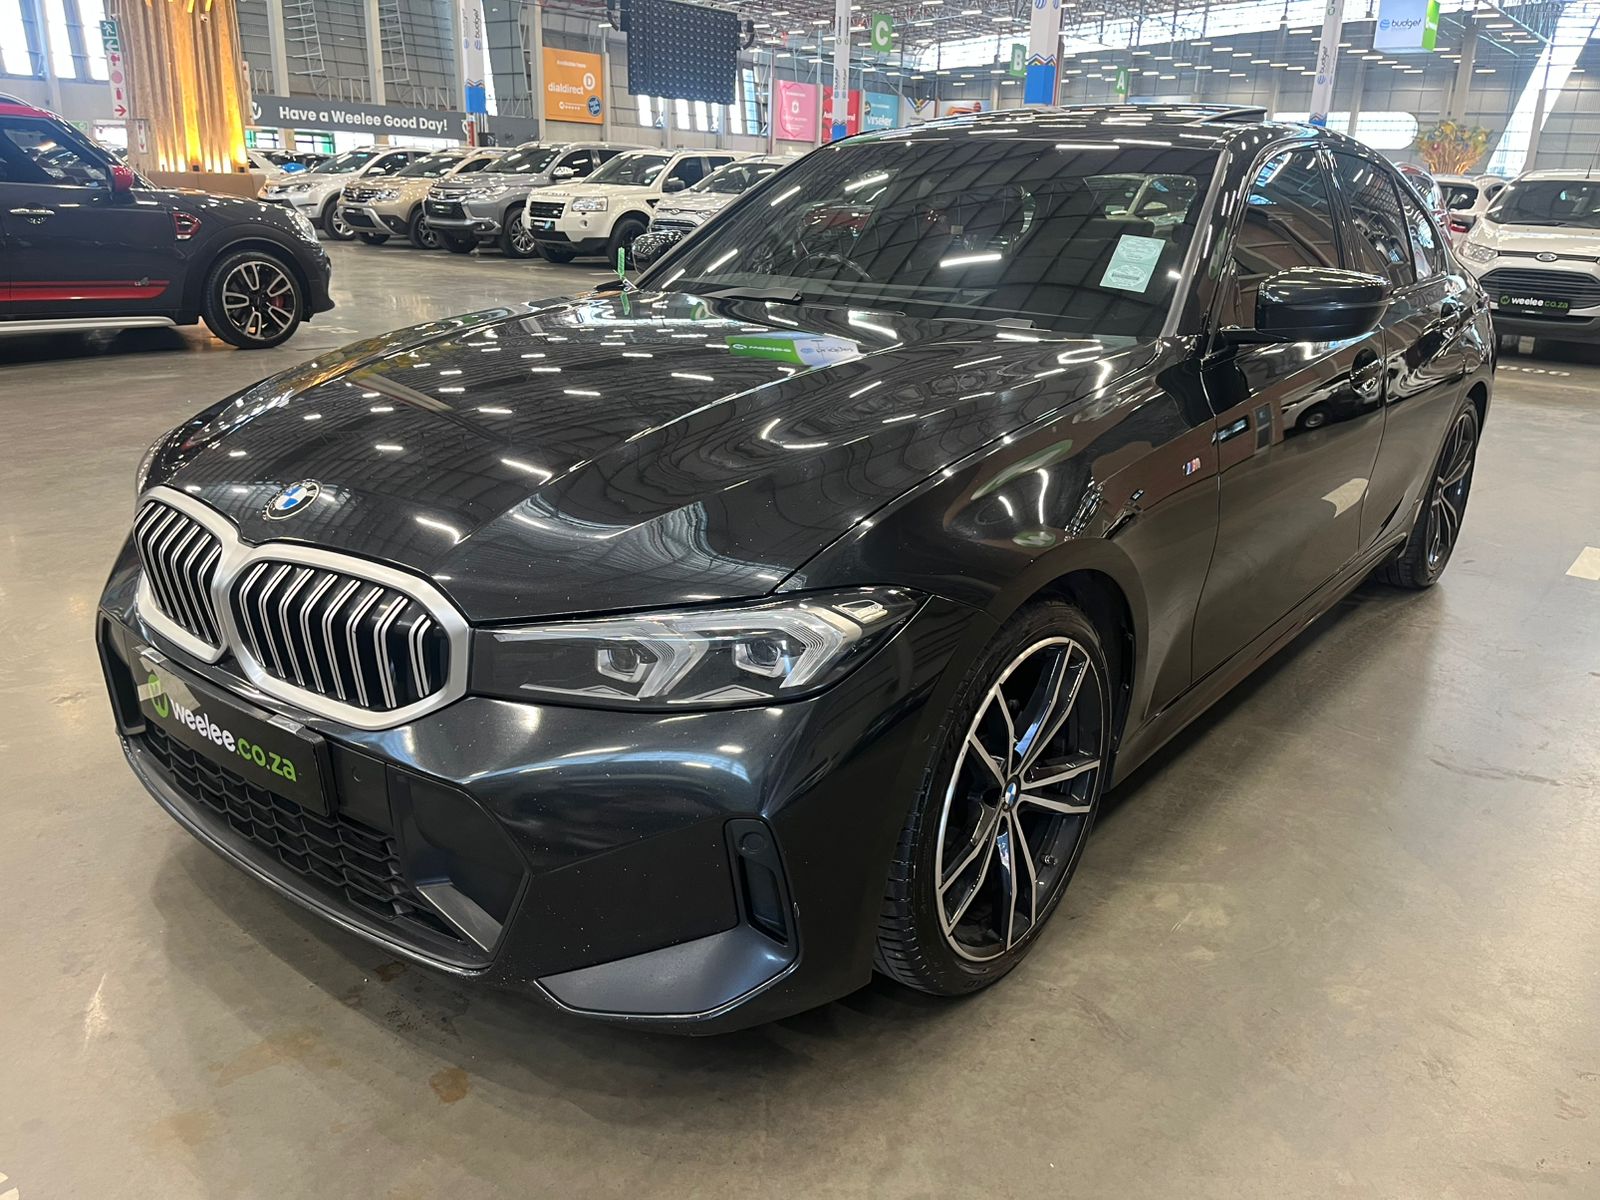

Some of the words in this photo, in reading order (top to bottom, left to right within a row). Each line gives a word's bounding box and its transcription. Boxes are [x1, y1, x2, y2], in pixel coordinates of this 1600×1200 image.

[875, 20, 889, 46] C
[1391, 18, 1422, 29] budget
[1013, 48, 1023, 71] B
[547, 82, 584, 95] dialdirect
[1117, 70, 1125, 90] A
[279, 106, 317, 121] Have
[319, 112, 329, 122] a
[331, 110, 381, 126] Weelee
[383, 115, 417, 128] Good
[419, 117, 448, 134] Day!
[170, 699, 297, 782] weelee.co.za
